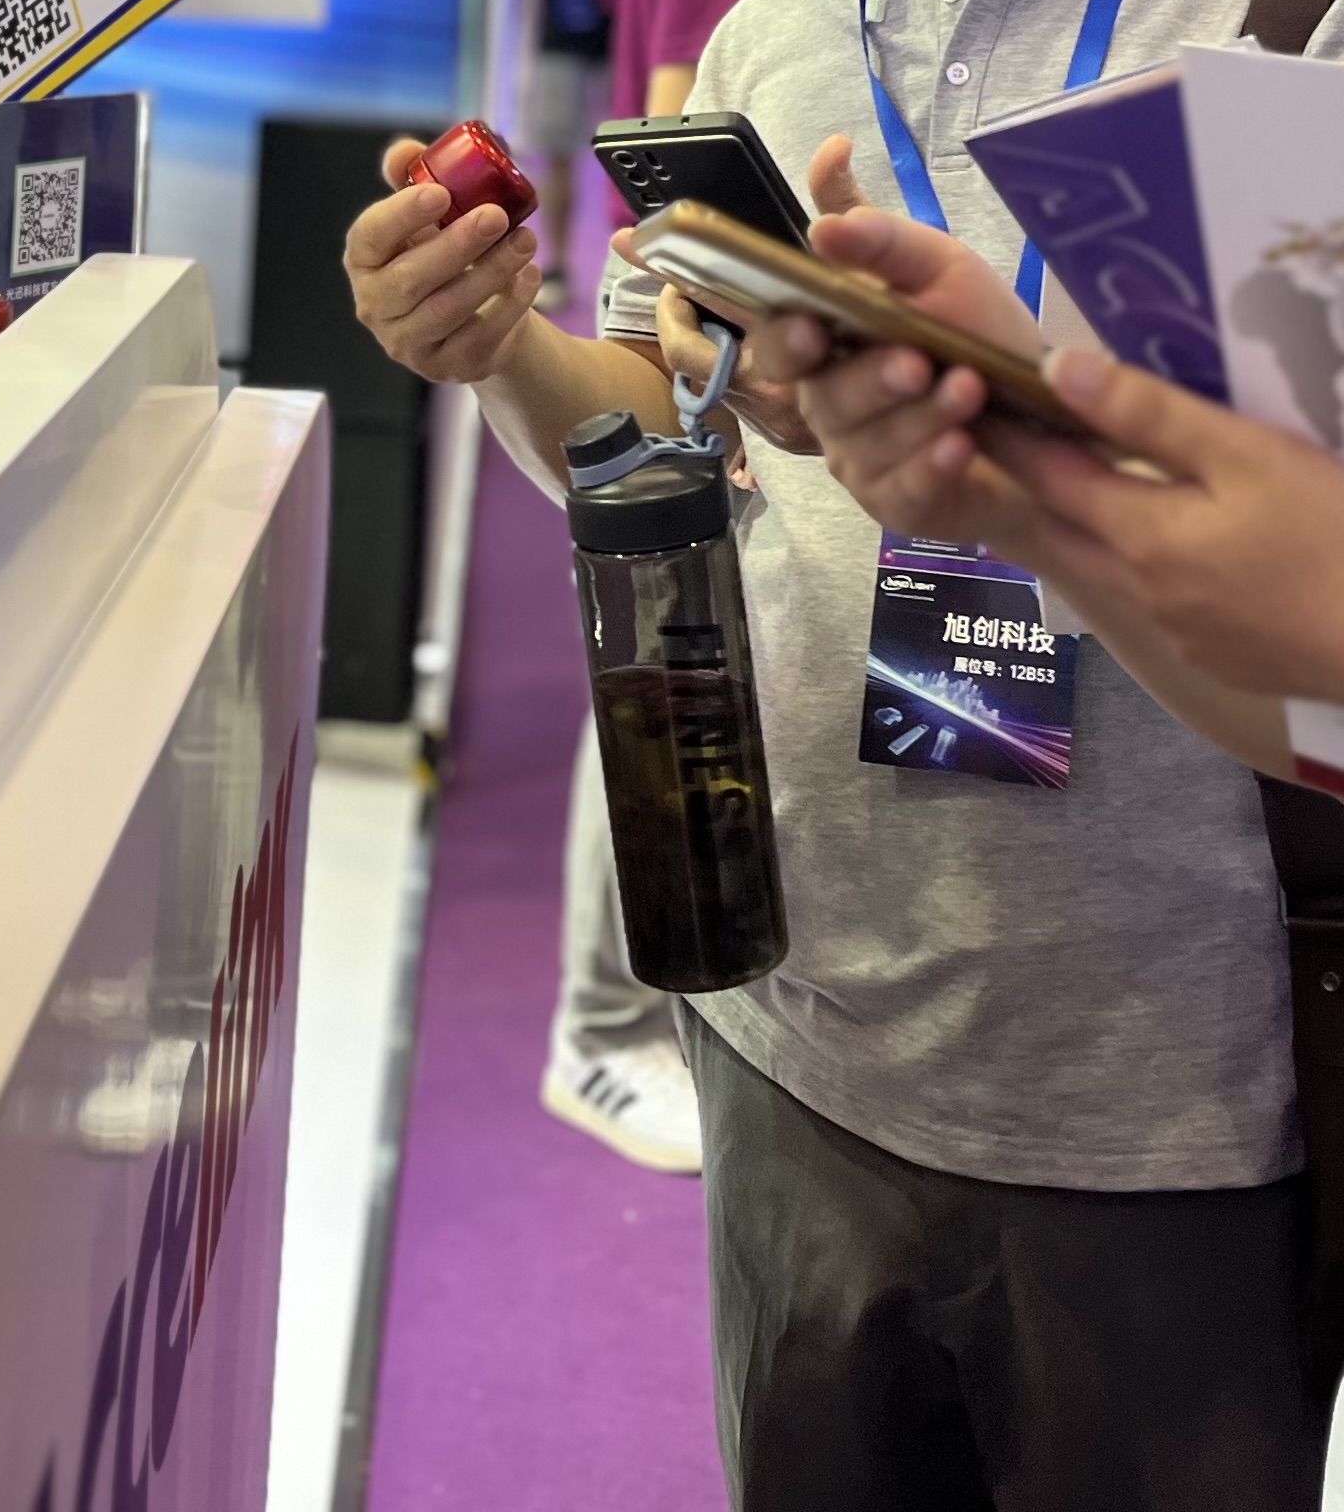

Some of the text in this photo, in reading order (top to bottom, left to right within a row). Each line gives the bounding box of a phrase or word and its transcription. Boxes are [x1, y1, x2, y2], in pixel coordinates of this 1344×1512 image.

[943, 612, 1056, 656] 旭创科技
[1009, 664, 1056, 684] 12B53
